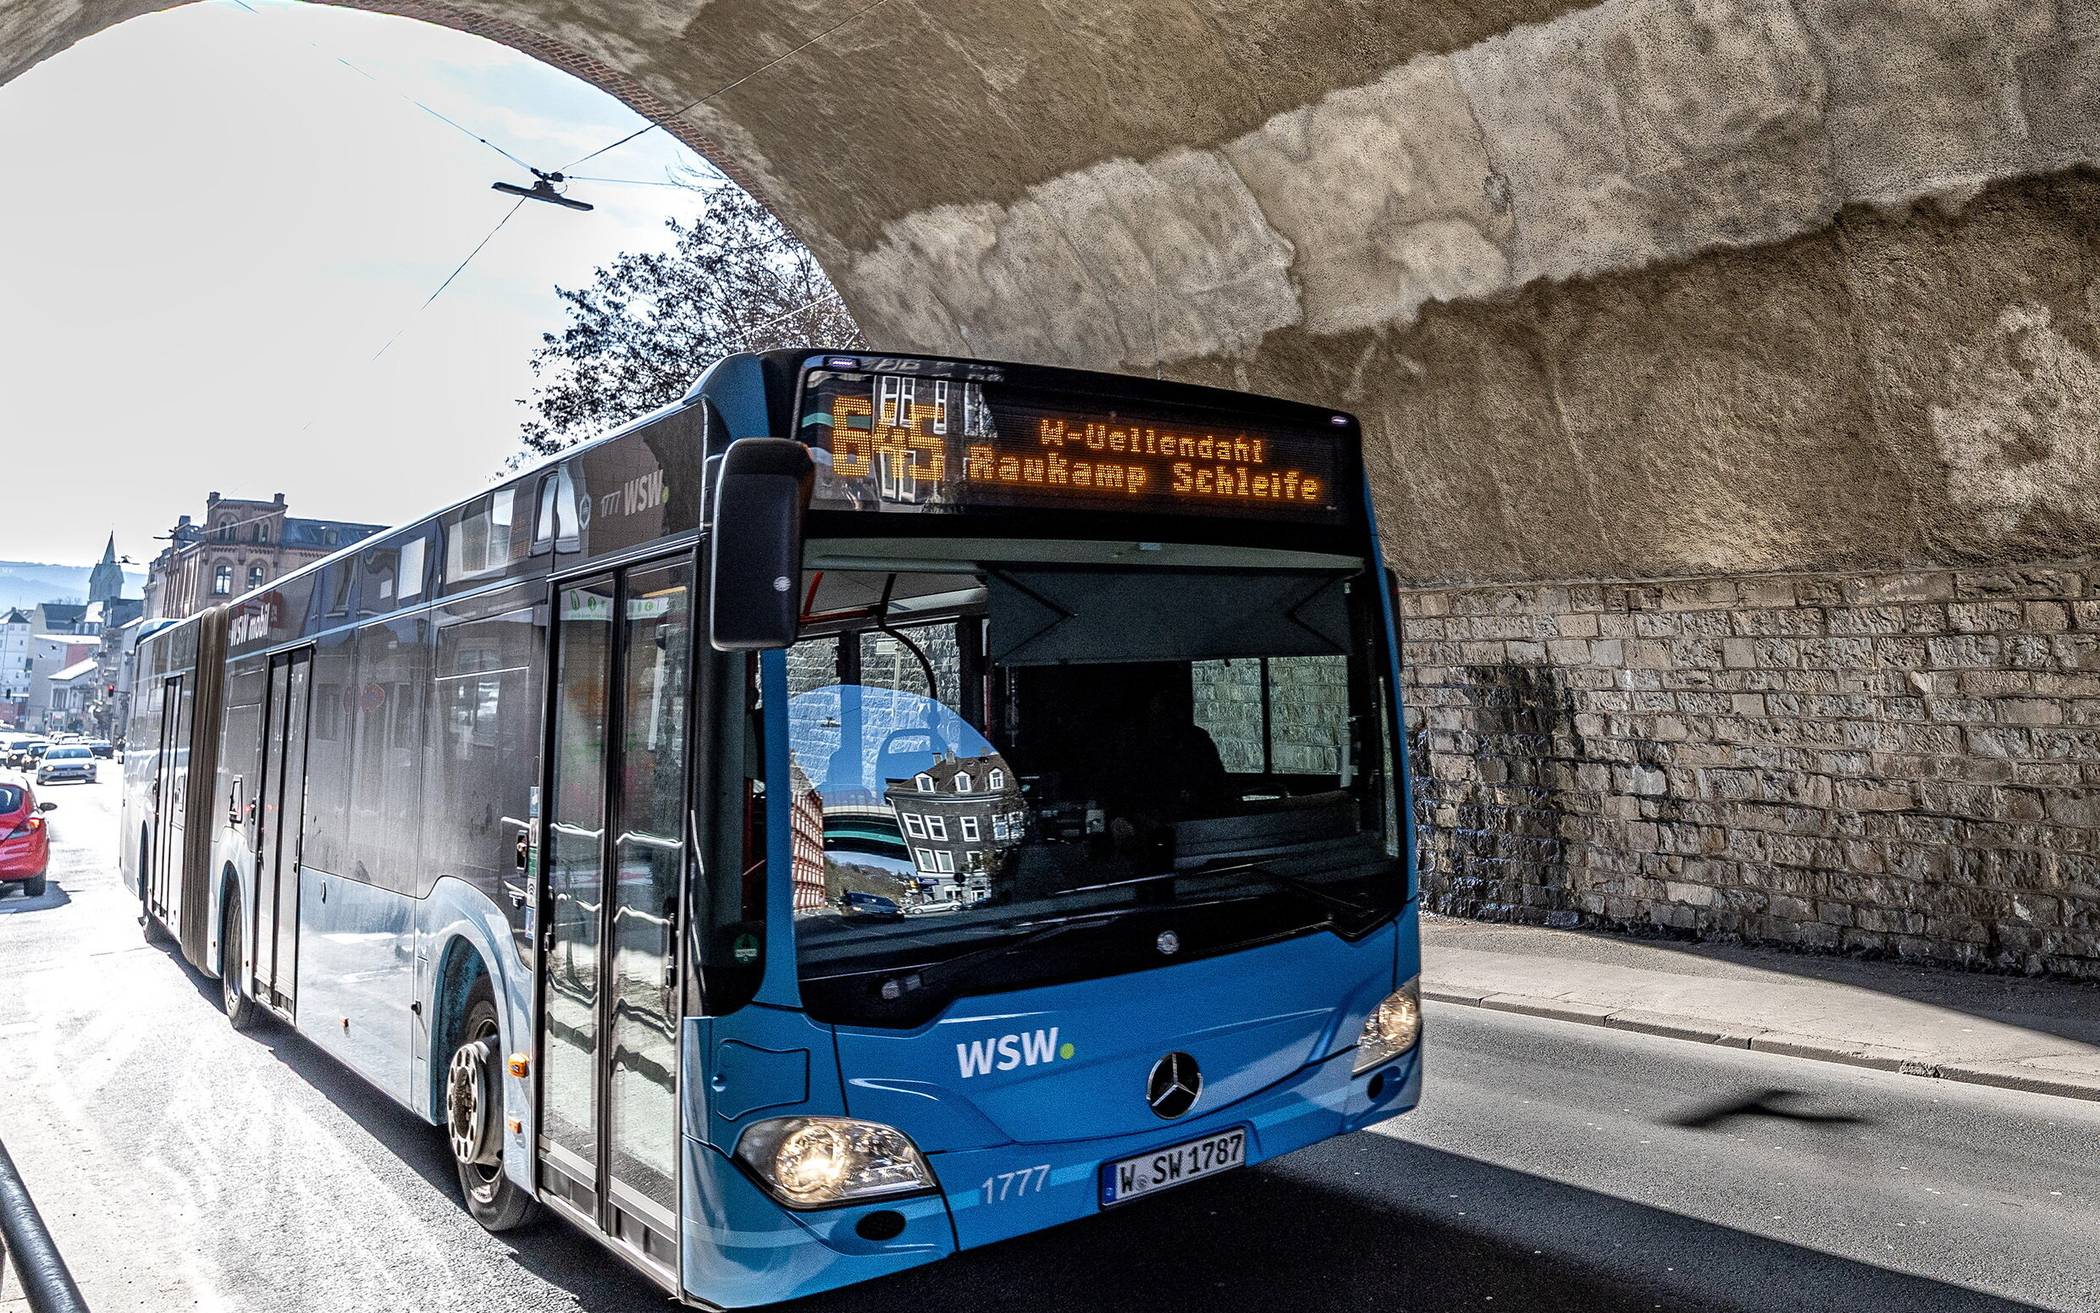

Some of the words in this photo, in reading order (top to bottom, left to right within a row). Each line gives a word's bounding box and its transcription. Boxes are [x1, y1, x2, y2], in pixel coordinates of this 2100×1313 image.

[832, 396, 945, 481] 645
[1040, 418, 1264, 464] W-Uellendahl
[968, 444, 1147, 493] Raukamp
[1172, 462, 1322, 501] Schleife
[601, 491, 621, 518] 1777
[1188, 1132, 1243, 1175] 1787
[981, 1164, 1051, 1205] 1777
